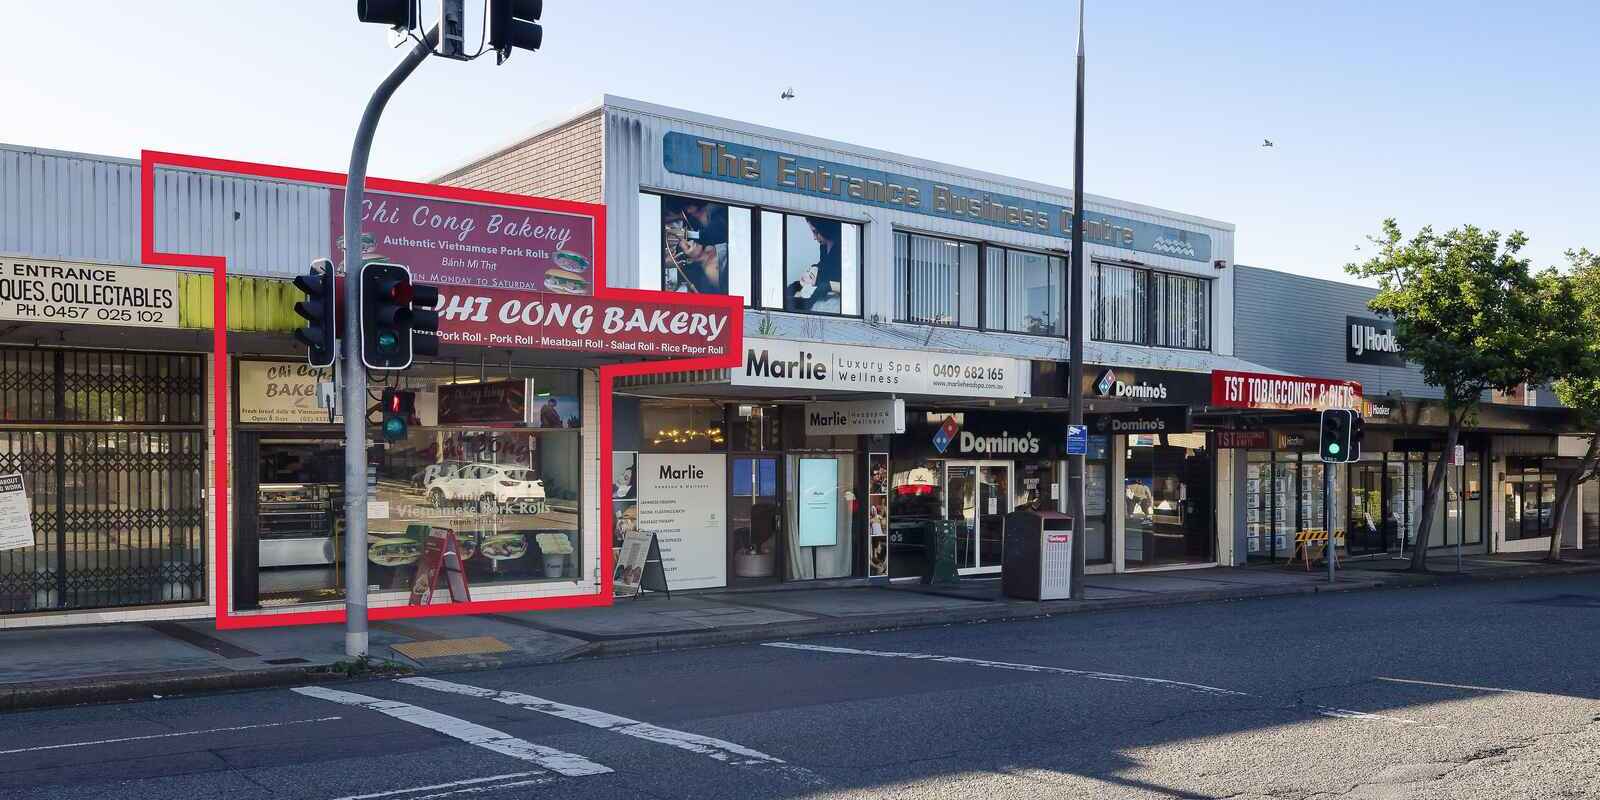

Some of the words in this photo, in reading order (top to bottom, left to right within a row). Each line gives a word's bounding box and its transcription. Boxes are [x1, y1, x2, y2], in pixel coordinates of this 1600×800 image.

[697, 141, 760, 178] The
[776, 154, 921, 208] Entrance
[933, 184, 1049, 230] Business
[412, 206, 476, 242] Cong
[487, 214, 572, 250] Bakery
[383, 235, 436, 249] Authentic
[438, 240, 498, 254] Vietnamese
[500, 246, 524, 257] Pork
[526, 248, 550, 259] Rolls
[13, 263, 116, 282] ENTRANCE
[430, 273, 472, 286] MONDAY
[492, 278, 535, 290] SATURDAY
[51, 281, 173, 310] COLLECTABLES
[43, 305, 89, 320] 0457
[97, 308, 132, 322] 025
[137, 310, 164, 323] 102
[498, 299, 593, 334] CONG
[603, 305, 728, 341] BAKERY
[462, 332, 481, 342] Roll
[489, 333, 513, 344] Pork
[515, 334, 533, 345] Roll
[541, 336, 582, 348] Meatball
[585, 338, 603, 349] Roll
[610, 341, 636, 351] Salad
[638, 342, 654, 351] Roll
[661, 343, 680, 352] Rice
[682, 344, 705, 356] Paper
[708, 345, 724, 354] Roll
[1364, 326, 1405, 353] Hooke
[746, 349, 827, 380] Marlie
[838, 357, 883, 373] Luxury
[888, 360, 911, 373] Spa
[915, 363, 921, 373] &
[932, 363, 960, 378] 0409
[964, 365, 984, 379] 682
[987, 367, 1004, 380] 165
[839, 371, 899, 384] Wellness
[266, 383, 318, 398] BAKE
[1116, 381, 1168, 399] Domino's
[1224, 376, 1244, 401] TST
[1248, 378, 1315, 405] TOBACCONIST
[1319, 385, 1326, 404] &
[1328, 384, 1354, 408] GIFTS
[810, 411, 847, 426] Marlie
[1112, 417, 1165, 431] Domino's
[960, 431, 1040, 453] Domino's
[660, 465, 704, 479] Marlie
